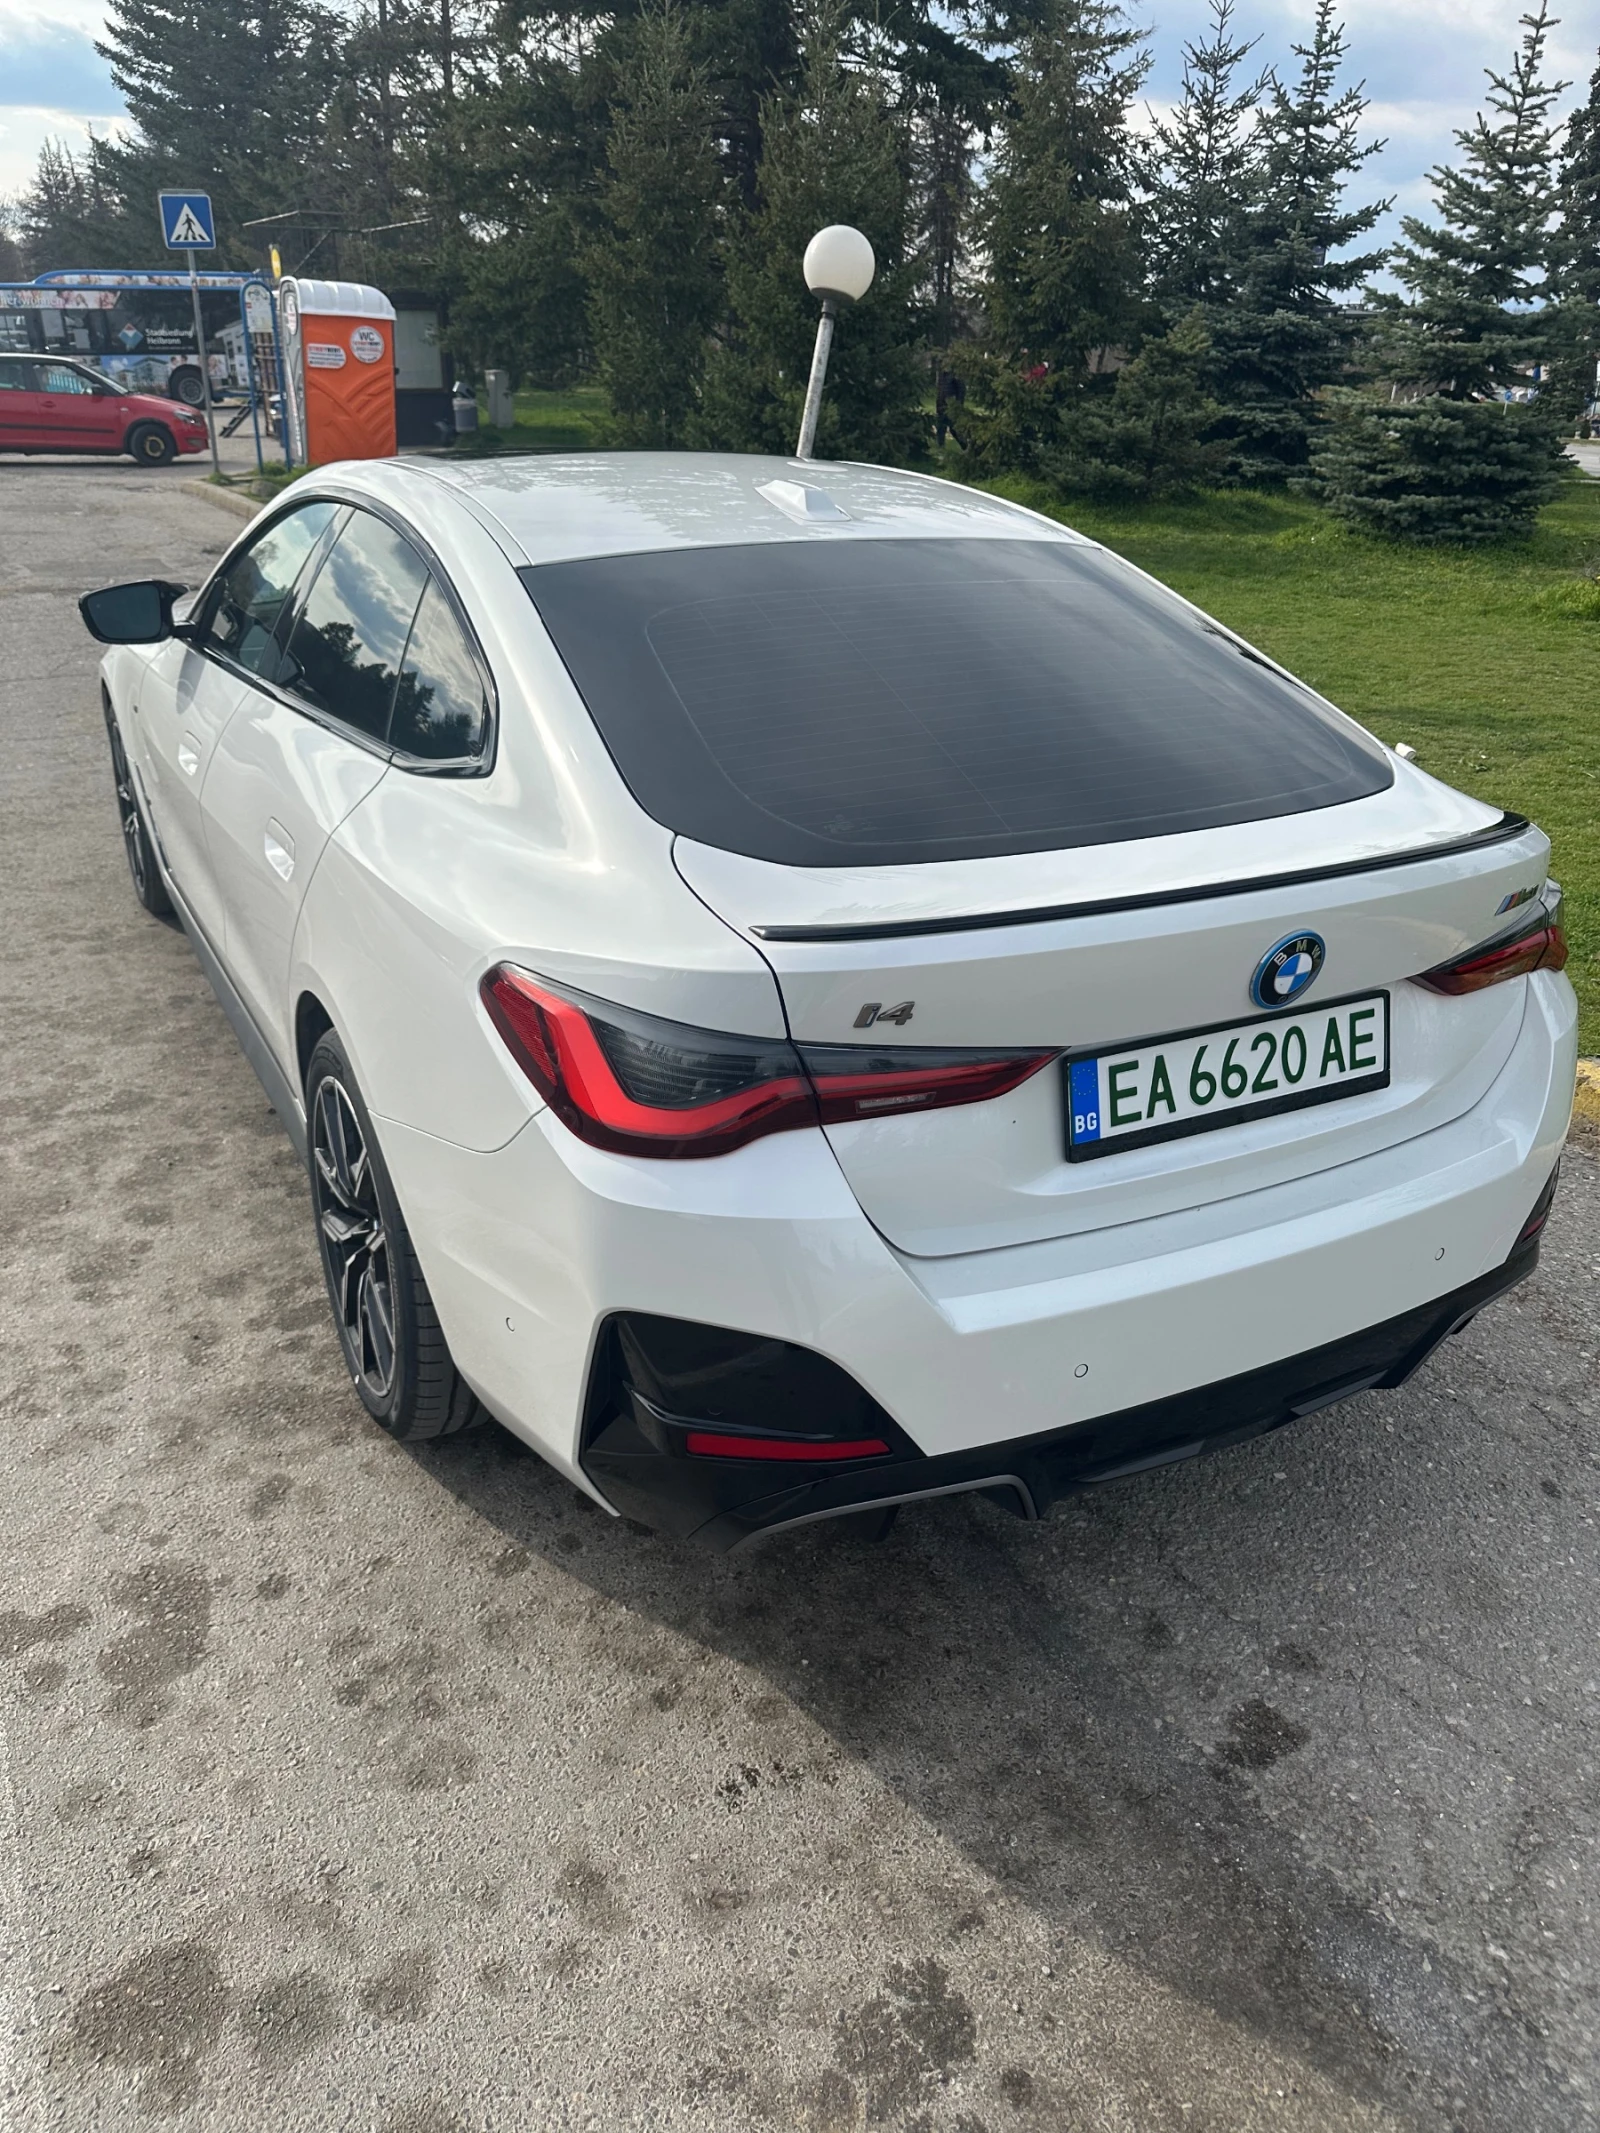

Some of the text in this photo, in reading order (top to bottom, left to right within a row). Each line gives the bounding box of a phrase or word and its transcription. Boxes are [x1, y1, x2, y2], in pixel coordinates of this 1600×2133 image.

[359, 331, 375, 341] WC
[1273, 939, 1322, 966] BMW
[1108, 1008, 1377, 1128] EA 6620 AE
[1075, 1111, 1097, 1134] BG
